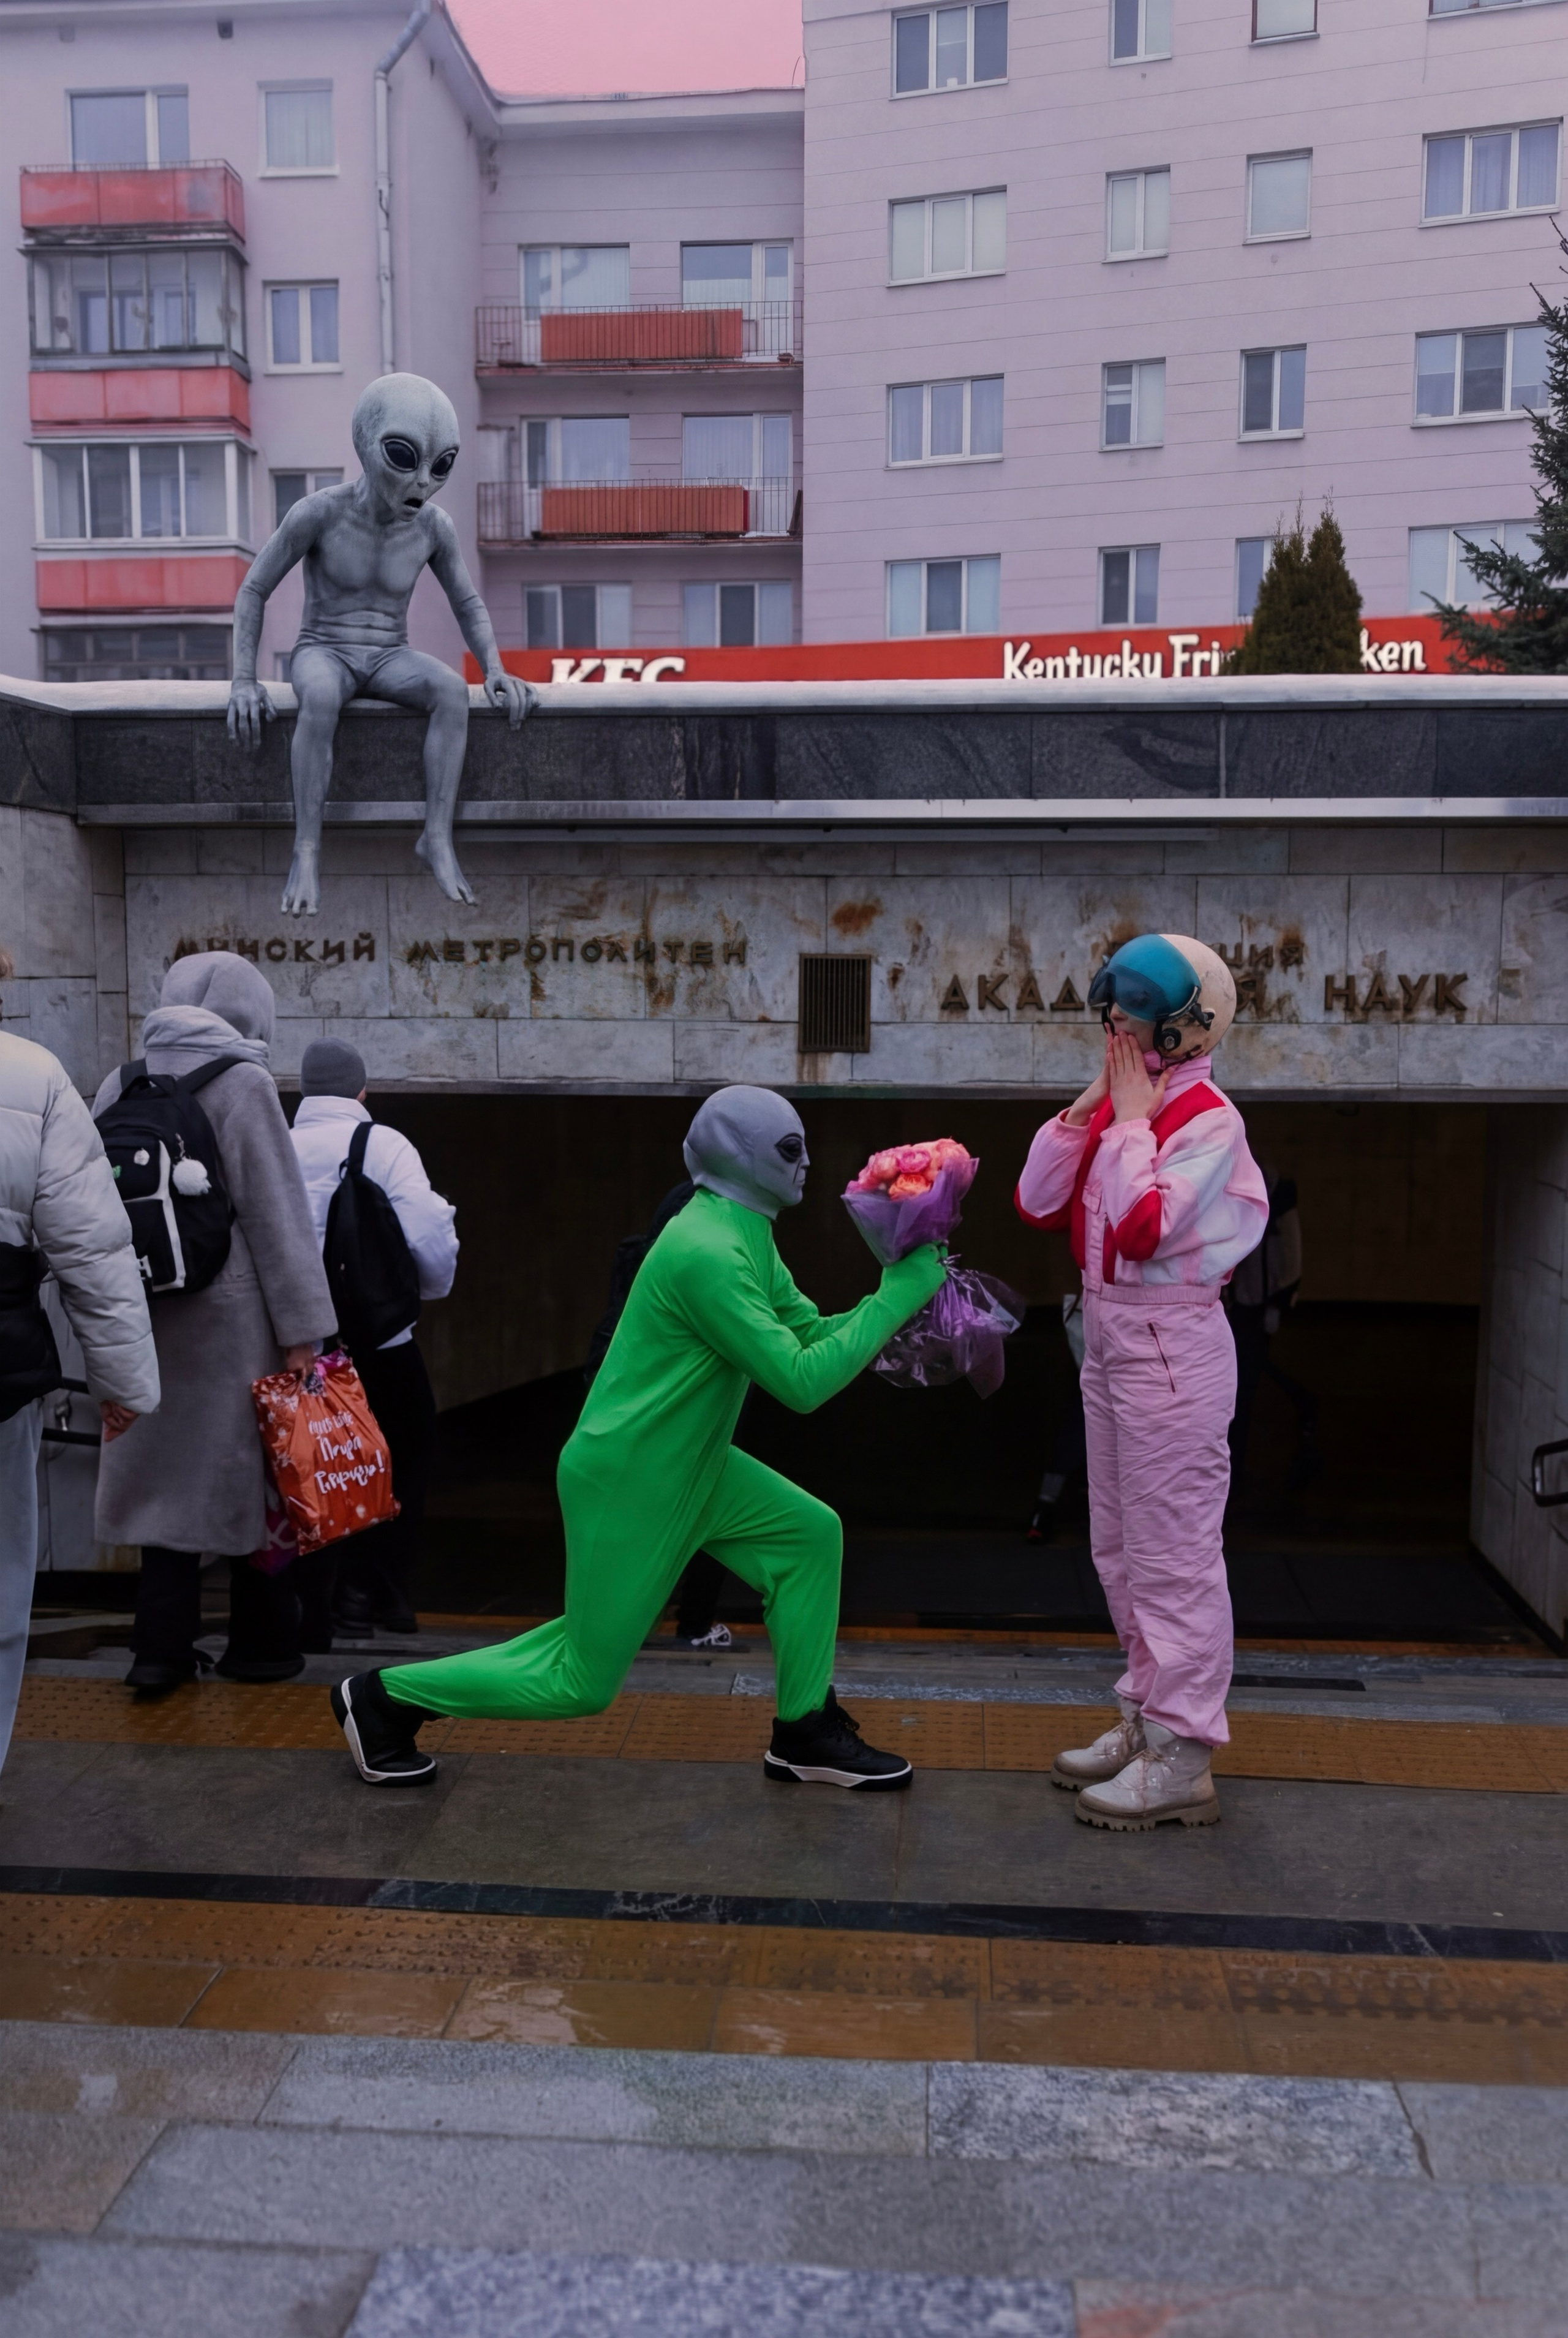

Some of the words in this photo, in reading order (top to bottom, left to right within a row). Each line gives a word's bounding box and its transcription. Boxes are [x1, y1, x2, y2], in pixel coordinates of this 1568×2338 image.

[551, 656, 685, 682] KFC
[1003, 639, 1163, 679] Kentucky
[1168, 633, 1236, 677] Fri
[406, 937, 747, 963] МЕТРОПОЛИТЕН
[940, 973, 1265, 1014] АКАДЯ
[1324, 973, 1468, 1012] НАУК
